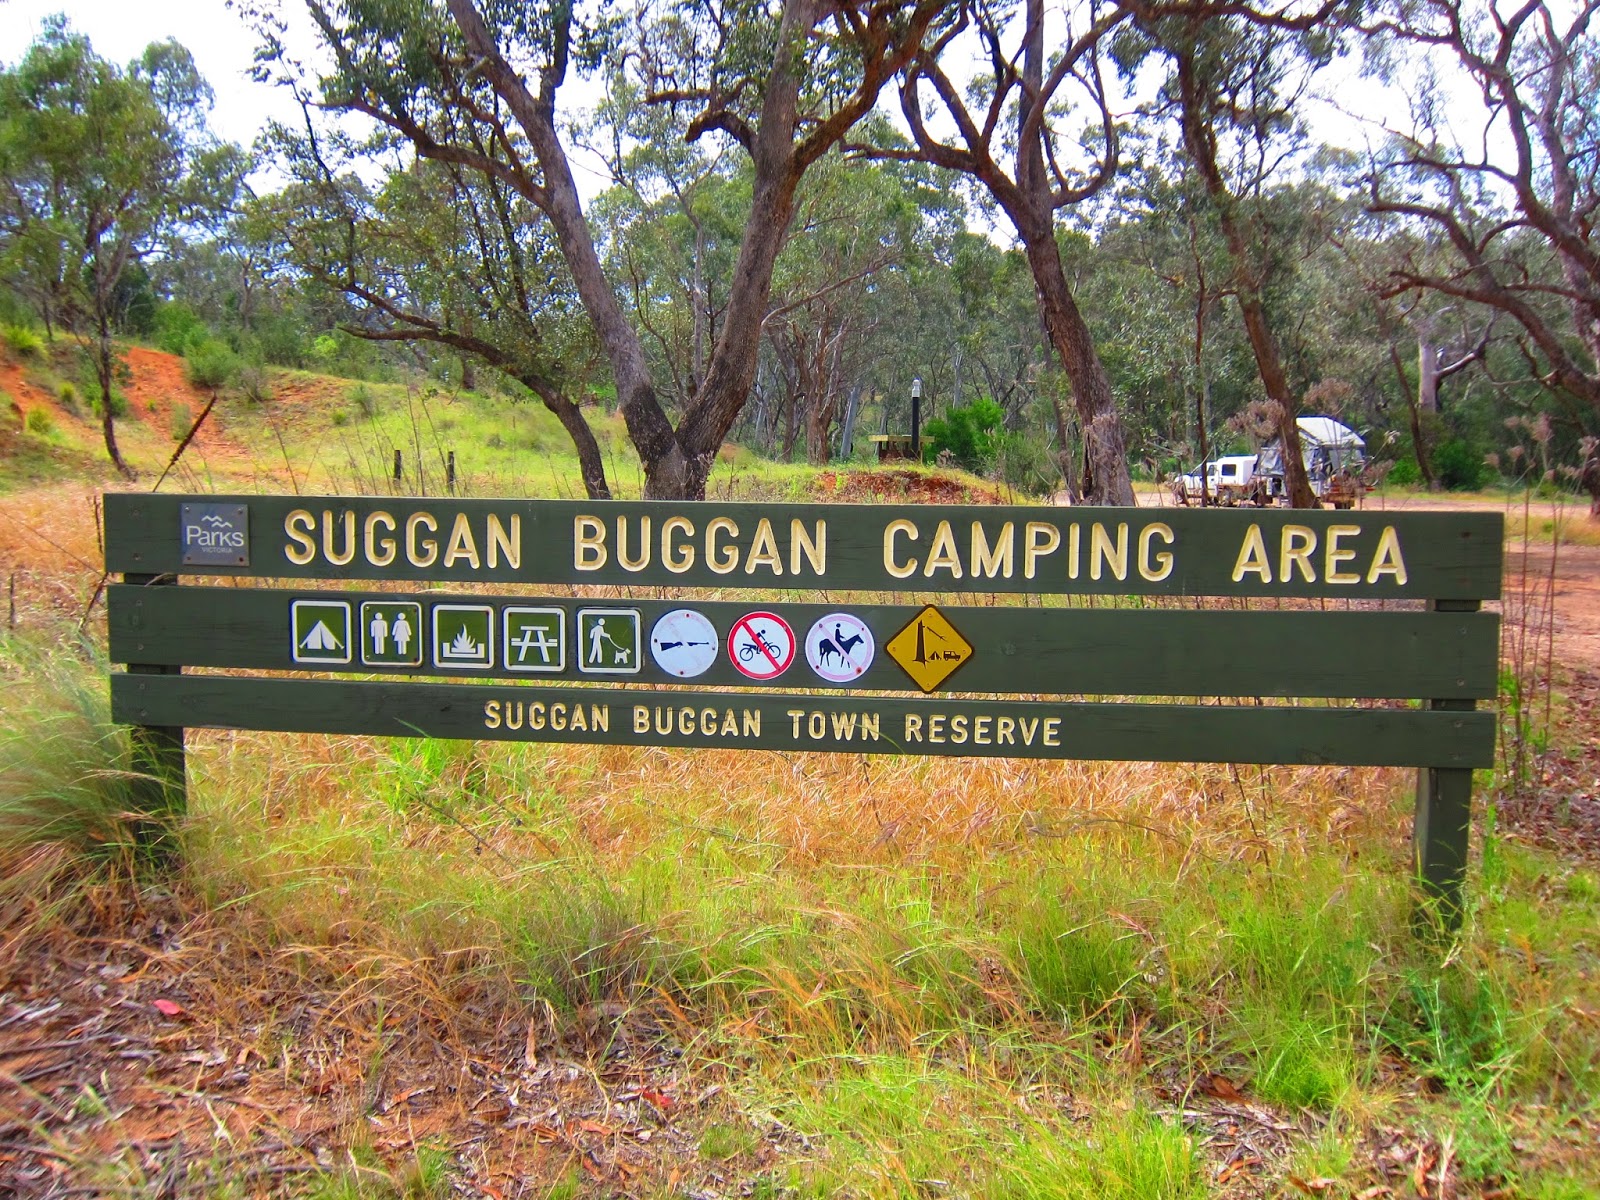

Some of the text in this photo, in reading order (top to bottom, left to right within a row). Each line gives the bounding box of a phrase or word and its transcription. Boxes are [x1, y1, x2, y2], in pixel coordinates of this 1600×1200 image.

[186, 525, 244, 547] Parks
[201, 546, 233, 554] VICTORIA
[284, 509, 1408, 586] SUGGAN BUGGAN CAMPING AREA
[484, 701, 1062, 746] SUGGAN BUGGAN TOWN RESERVE
